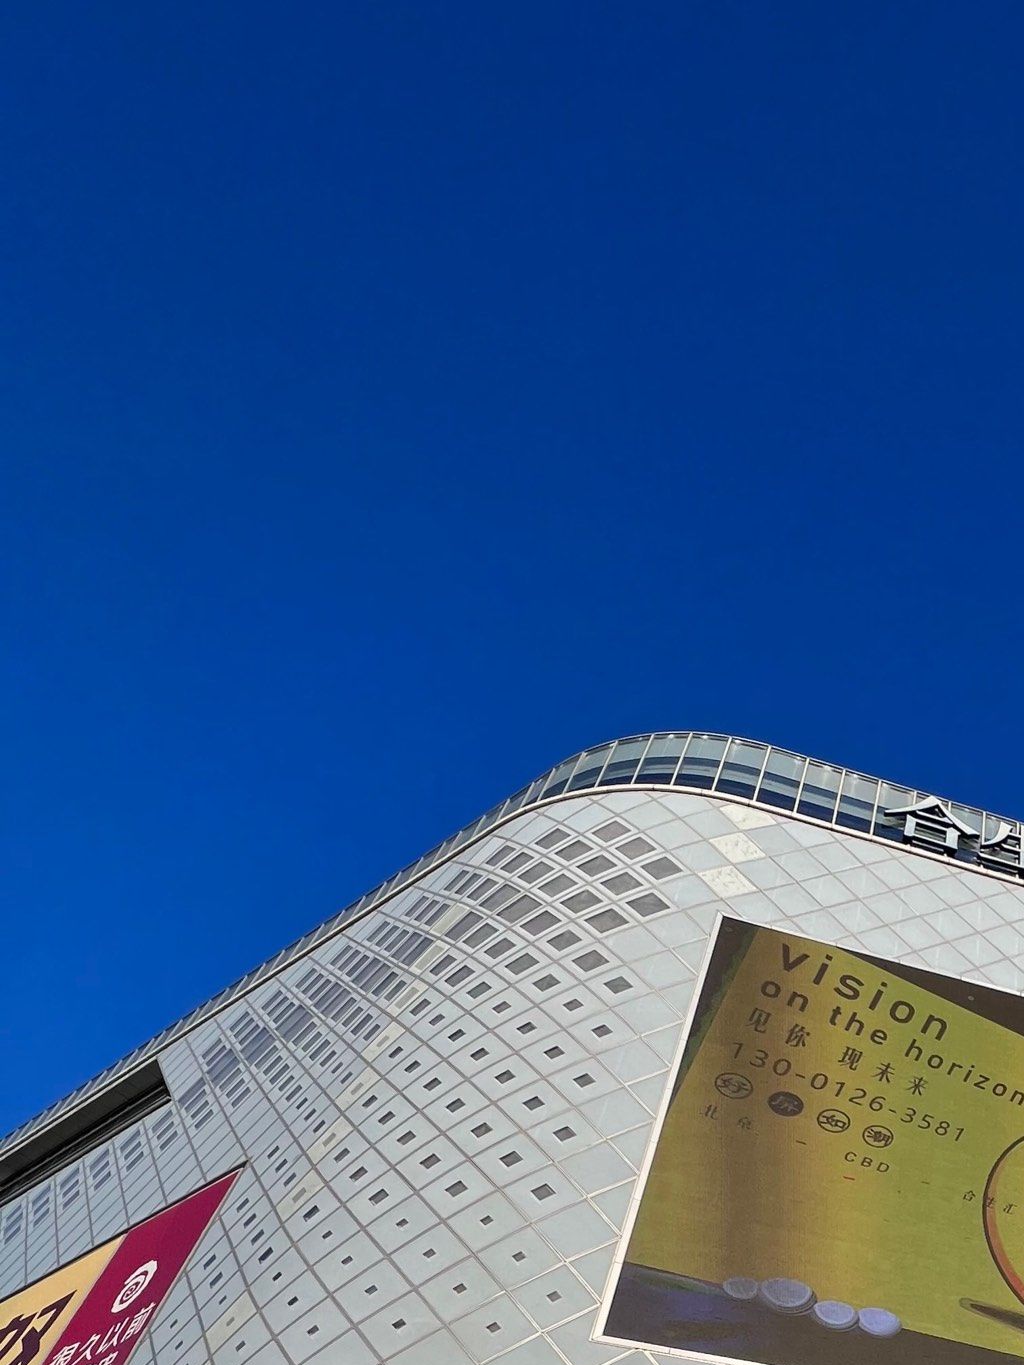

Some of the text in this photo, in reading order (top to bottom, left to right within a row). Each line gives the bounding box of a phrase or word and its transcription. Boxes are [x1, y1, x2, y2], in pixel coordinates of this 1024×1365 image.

[760, 980, 810, 1013] on
[829, 1006, 889, 1045] the
[780, 943, 949, 1042] vision
[731, 1041, 966, 1143] 130-0126-3581
[843, 1151, 891, 1173] CBD
